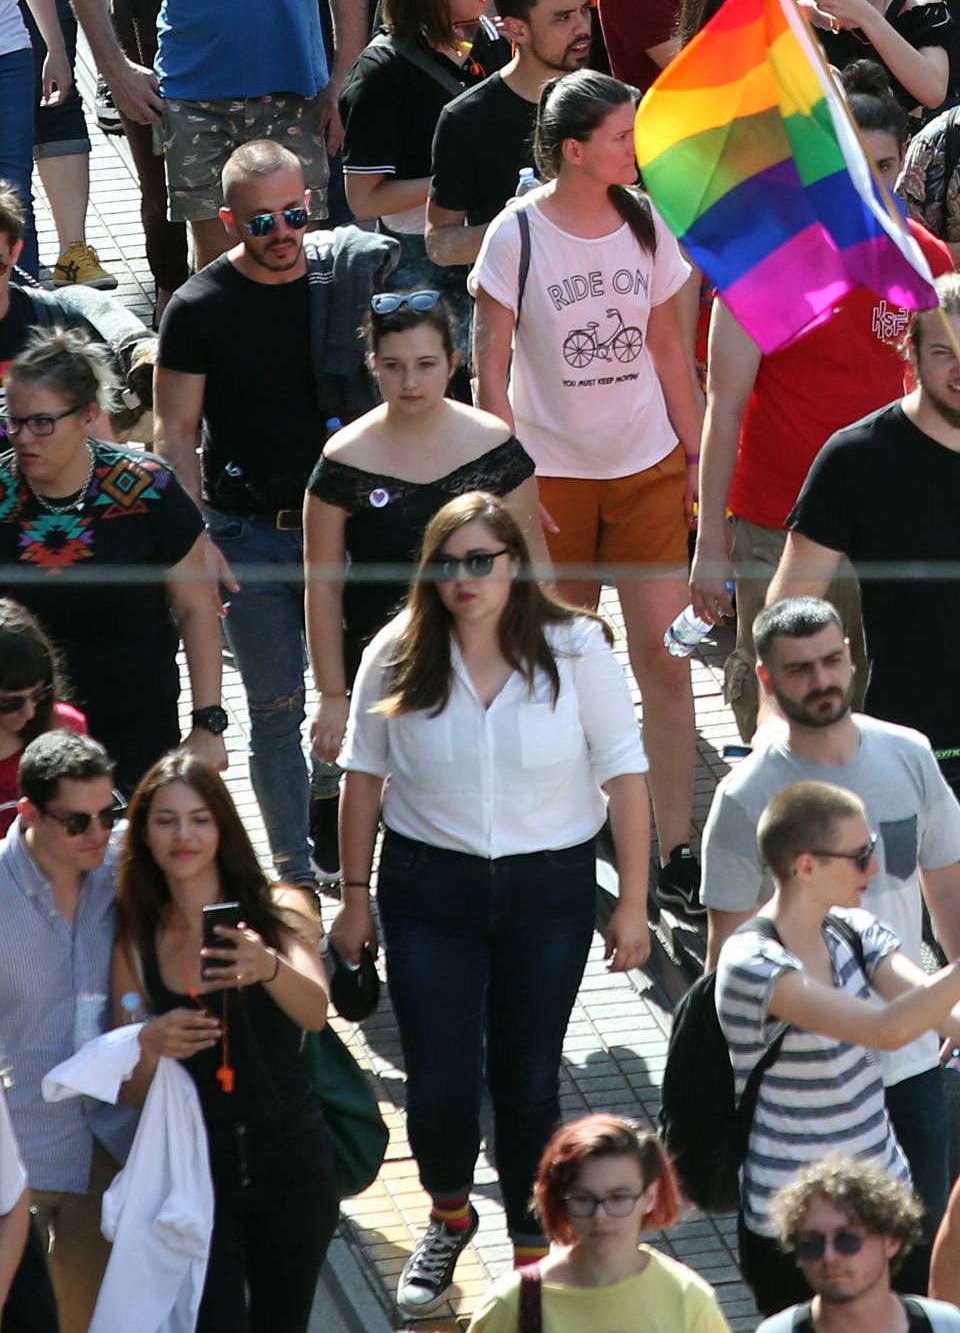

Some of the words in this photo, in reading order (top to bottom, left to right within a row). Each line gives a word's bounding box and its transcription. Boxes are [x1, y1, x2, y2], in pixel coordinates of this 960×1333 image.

[547, 271, 605, 311] RIDE
[612, 269, 649, 299] ON
[562, 379, 576, 387] YOU
[577, 378, 596, 387] MUST
[598, 376, 614, 385] KEEP
